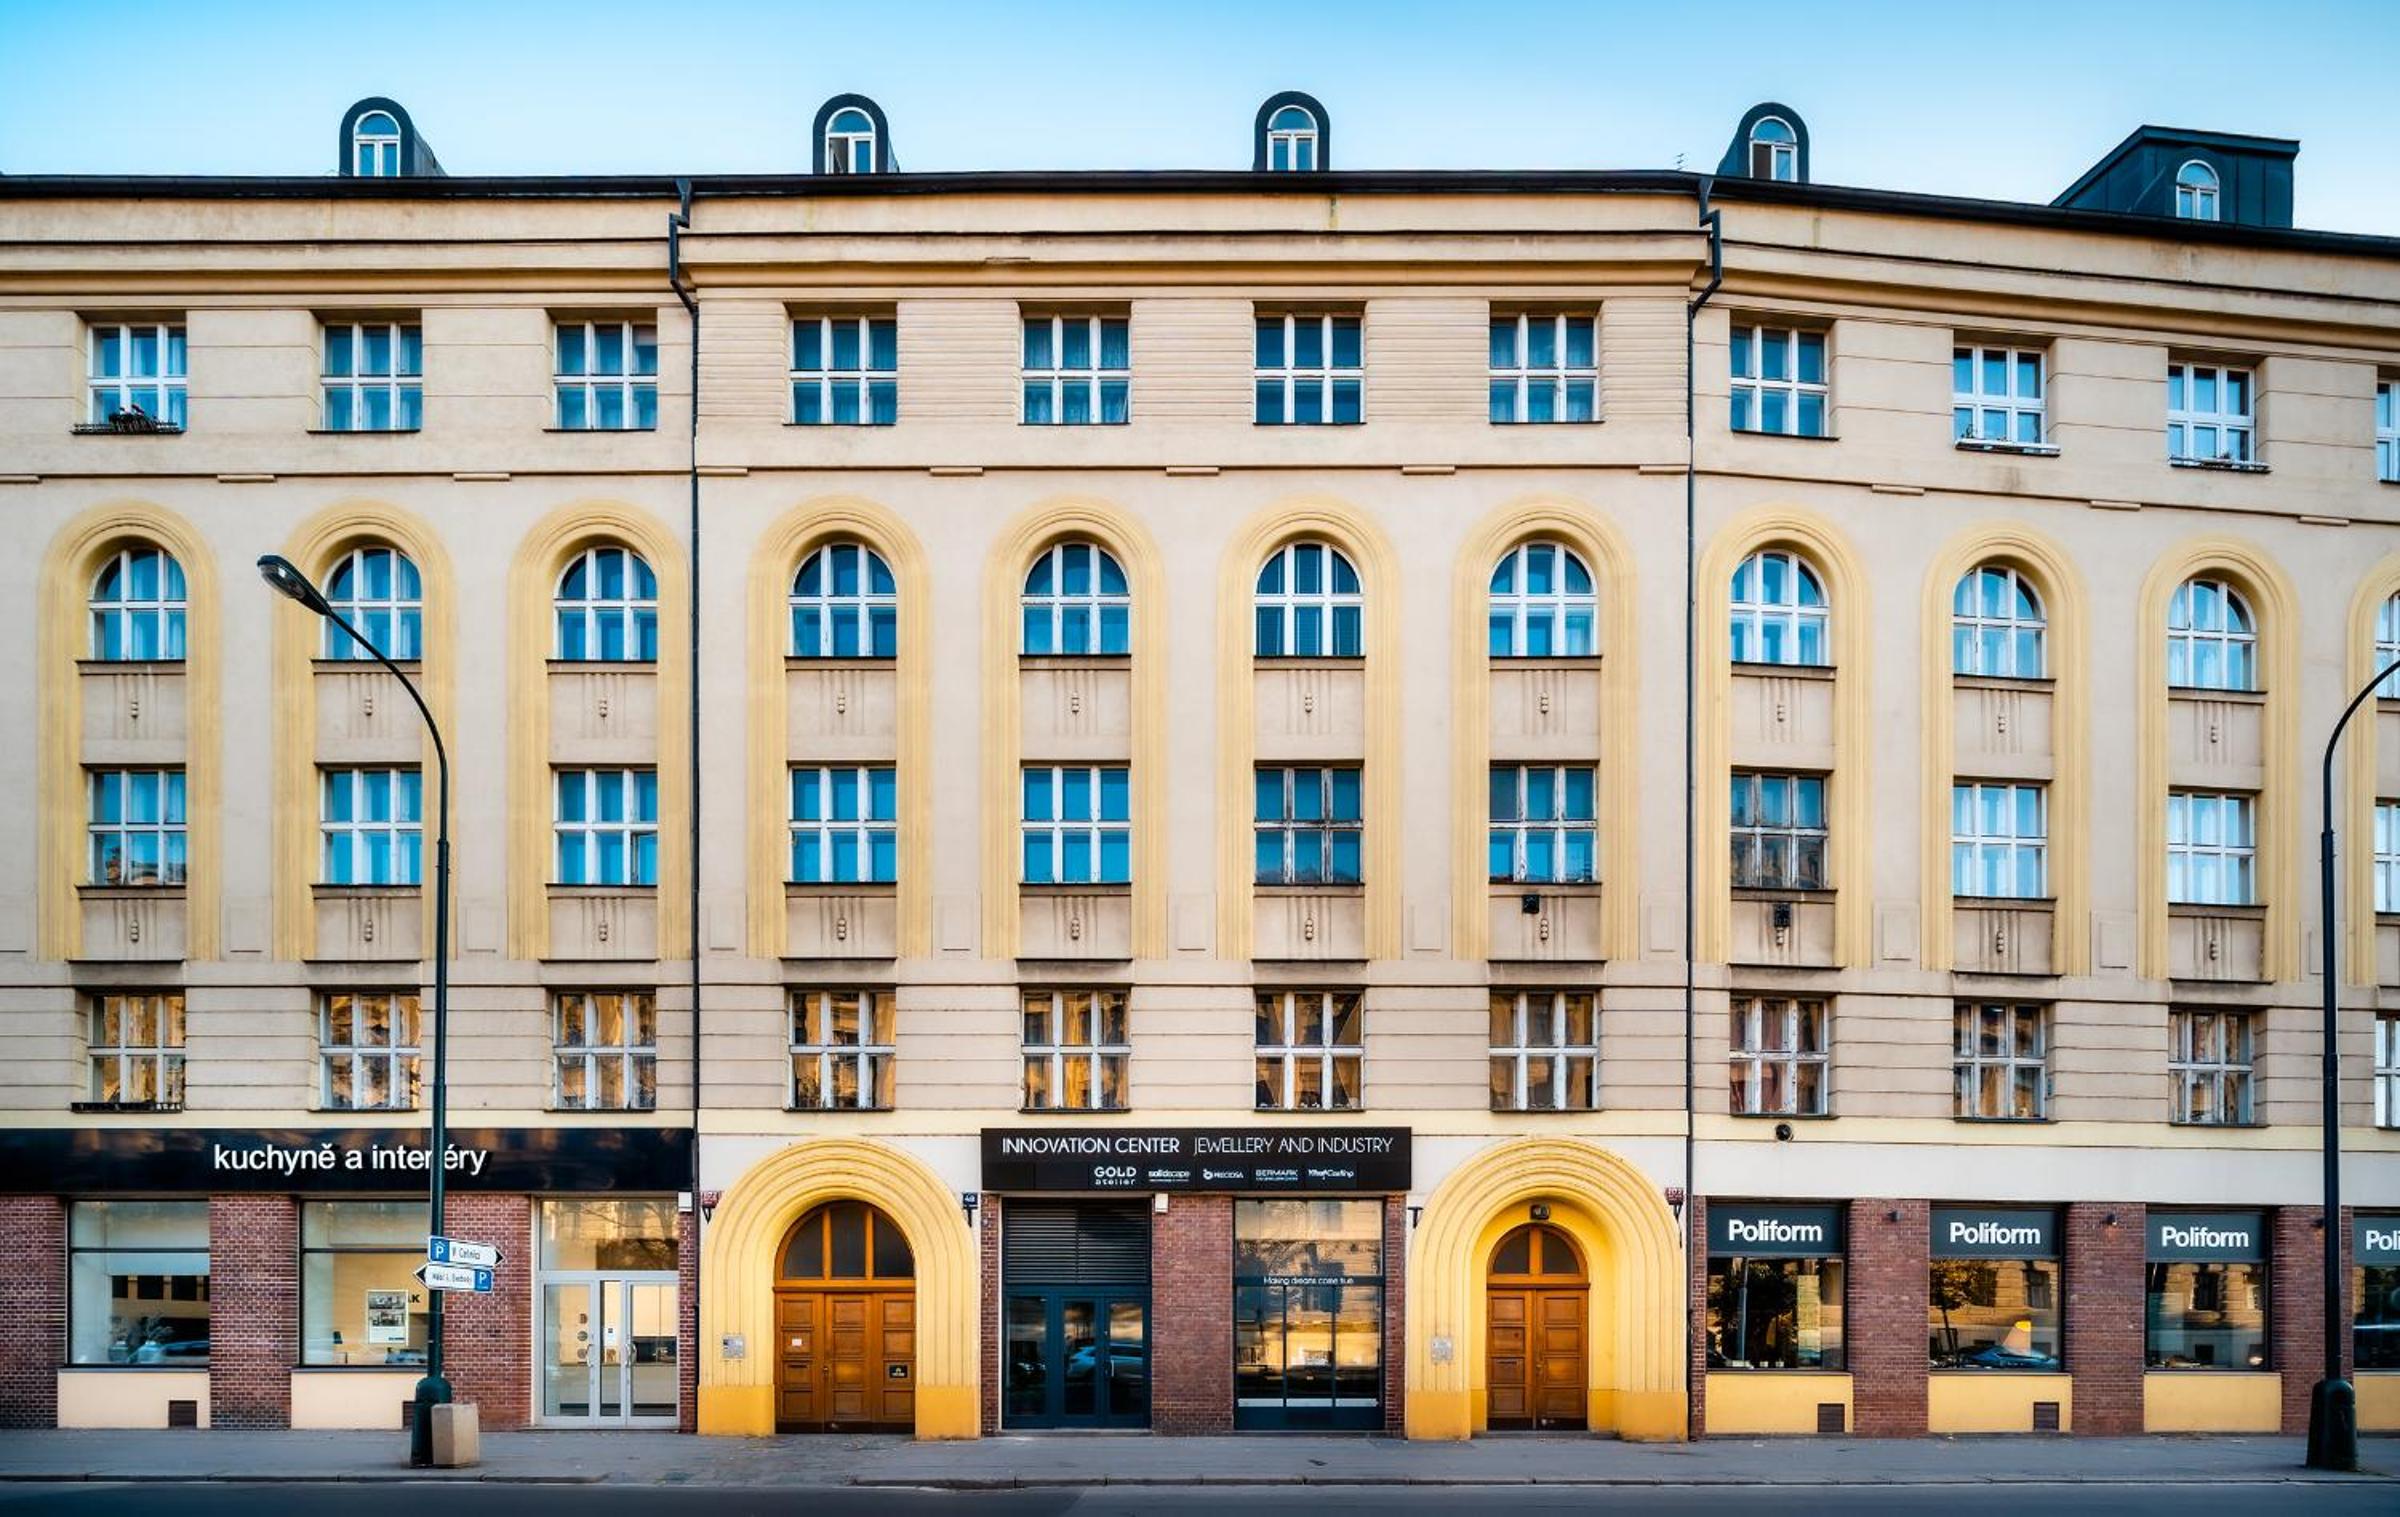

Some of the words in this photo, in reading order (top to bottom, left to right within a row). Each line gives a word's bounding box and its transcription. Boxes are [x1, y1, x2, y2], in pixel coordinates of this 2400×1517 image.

[1002, 1137, 1110, 1153] INNOVATION
[1115, 1137, 1180, 1153] CENTER
[1193, 1137, 1274, 1156] JEWELLERY
[1278, 1137, 1314, 1153] AND
[1317, 1137, 1394, 1153] INDUSTRY
[214, 1143, 336, 1176] kuchyně
[344, 1150, 363, 1170] a
[372, 1143, 487, 1176] interéry
[1094, 1166, 1137, 1178] GOLD
[1728, 1219, 1823, 1242] Poliform
[1949, 1222, 2041, 1244] Poliform
[2161, 1226, 2249, 1247] Poliform
